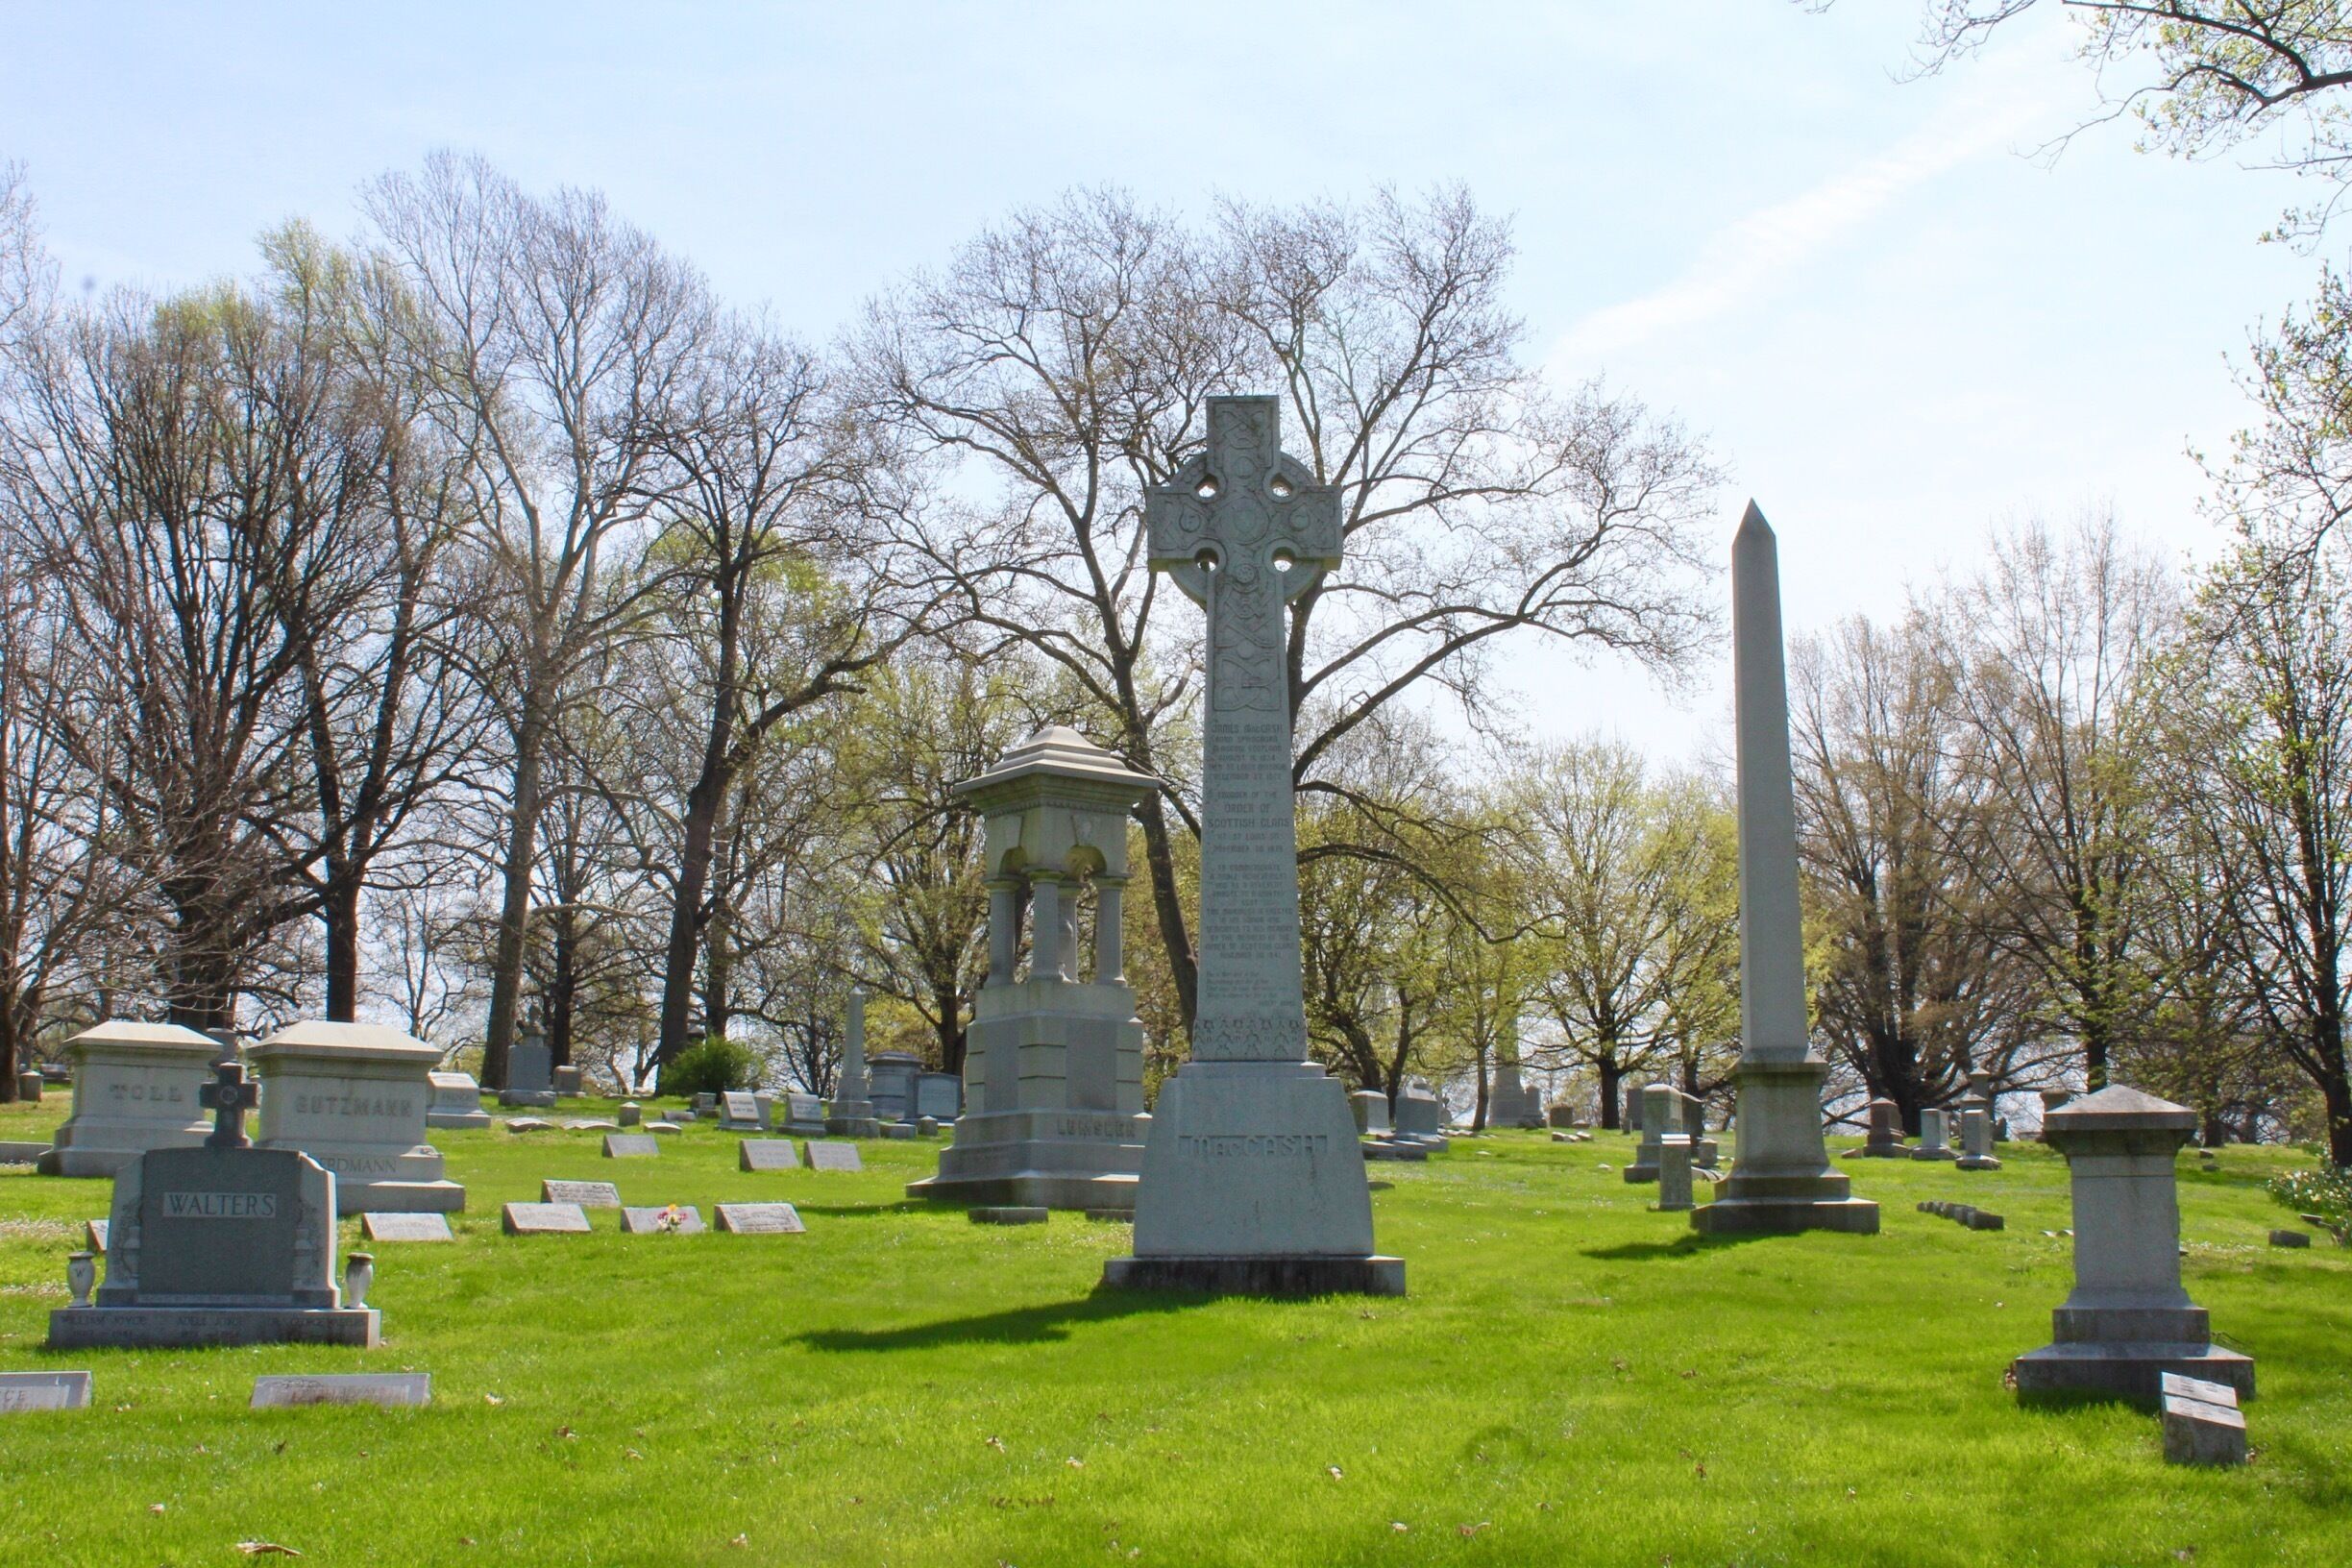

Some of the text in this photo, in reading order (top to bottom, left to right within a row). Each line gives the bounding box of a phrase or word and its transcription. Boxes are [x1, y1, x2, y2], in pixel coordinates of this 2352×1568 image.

[1208, 818, 1255, 827] SCOTTISH
[109, 1084, 183, 1102] TOLL
[169, 1194, 274, 1216] WALTERS
